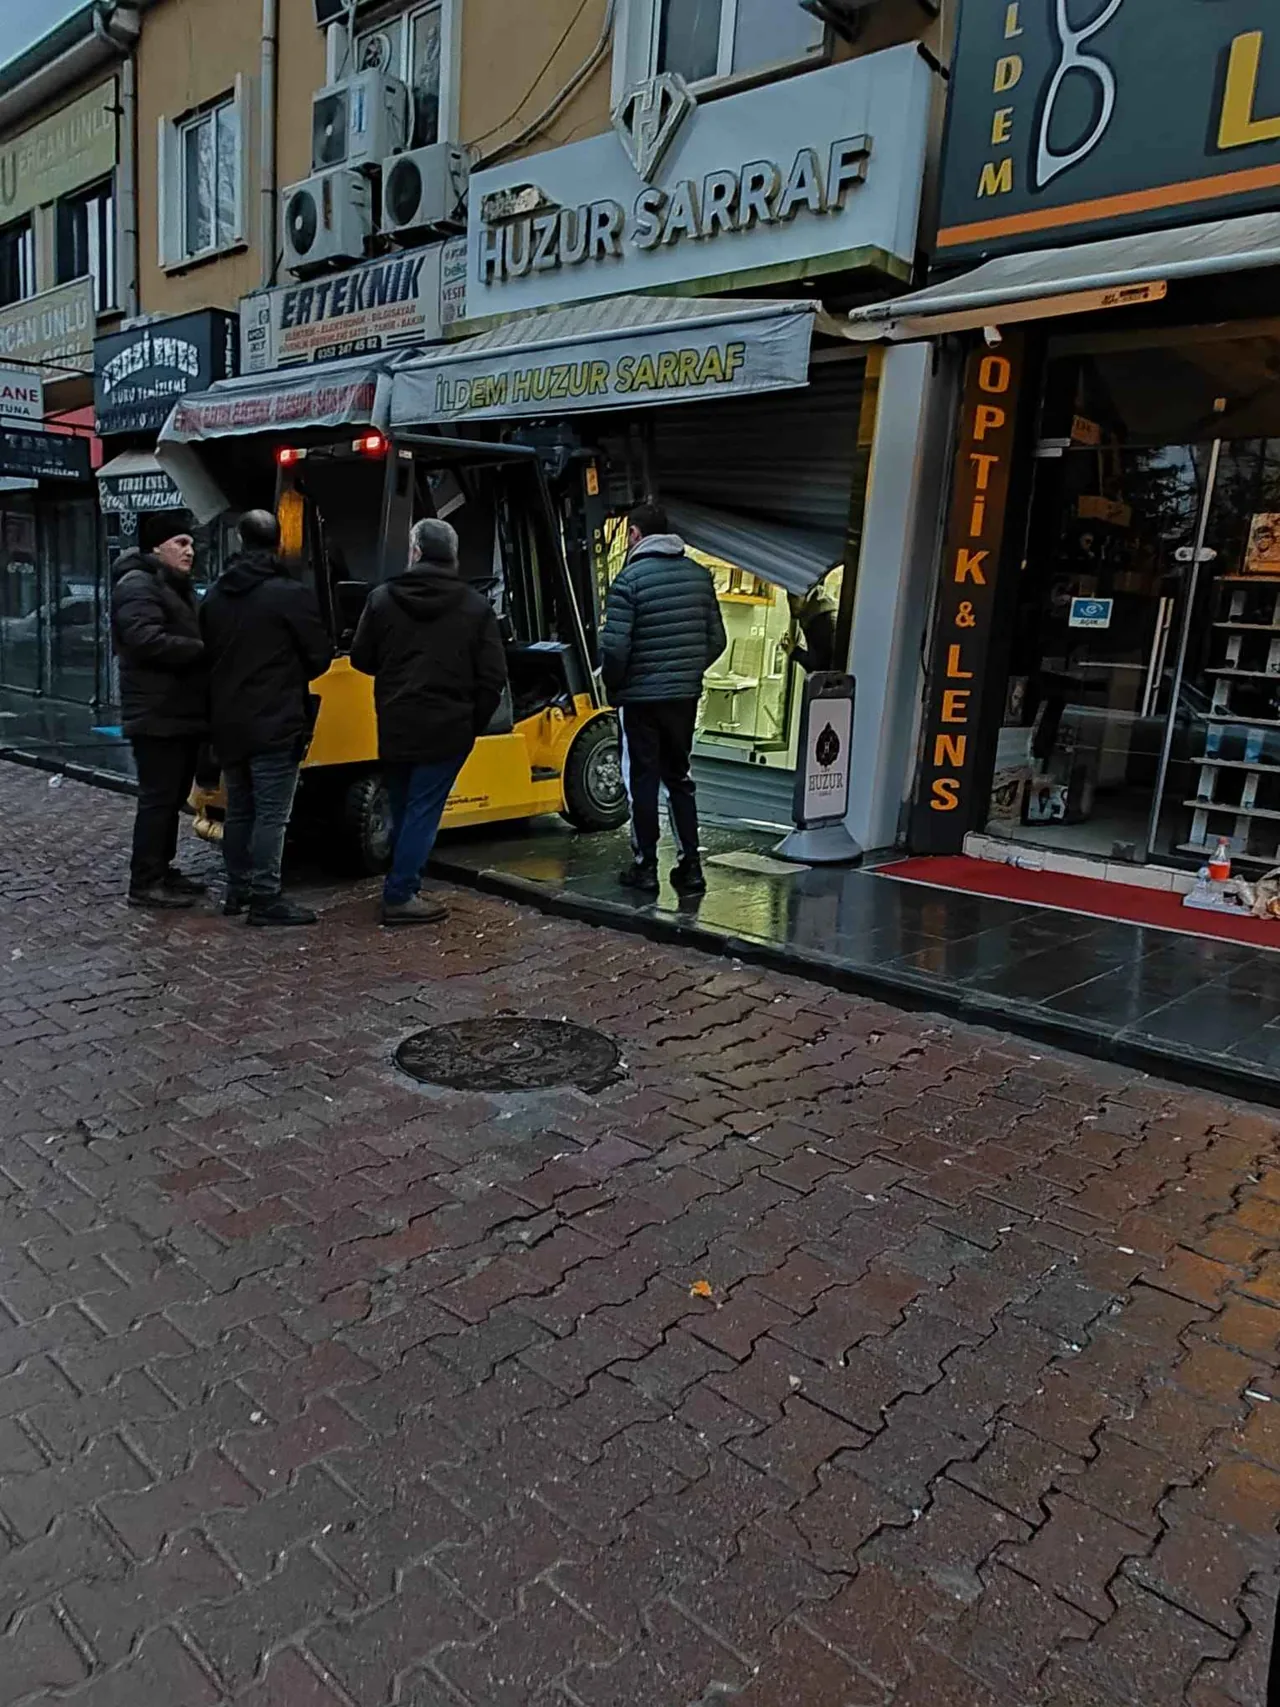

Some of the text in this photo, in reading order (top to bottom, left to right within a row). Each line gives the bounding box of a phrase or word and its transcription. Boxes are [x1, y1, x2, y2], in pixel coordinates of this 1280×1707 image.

[477, 132, 873, 286] HUZUR SARRAF
[434, 341, 747, 413] İLDEM HUZUR SARRAF
[930, 355, 1011, 812] OPTİK & LENS
[808, 772, 844, 792] HUZUR
